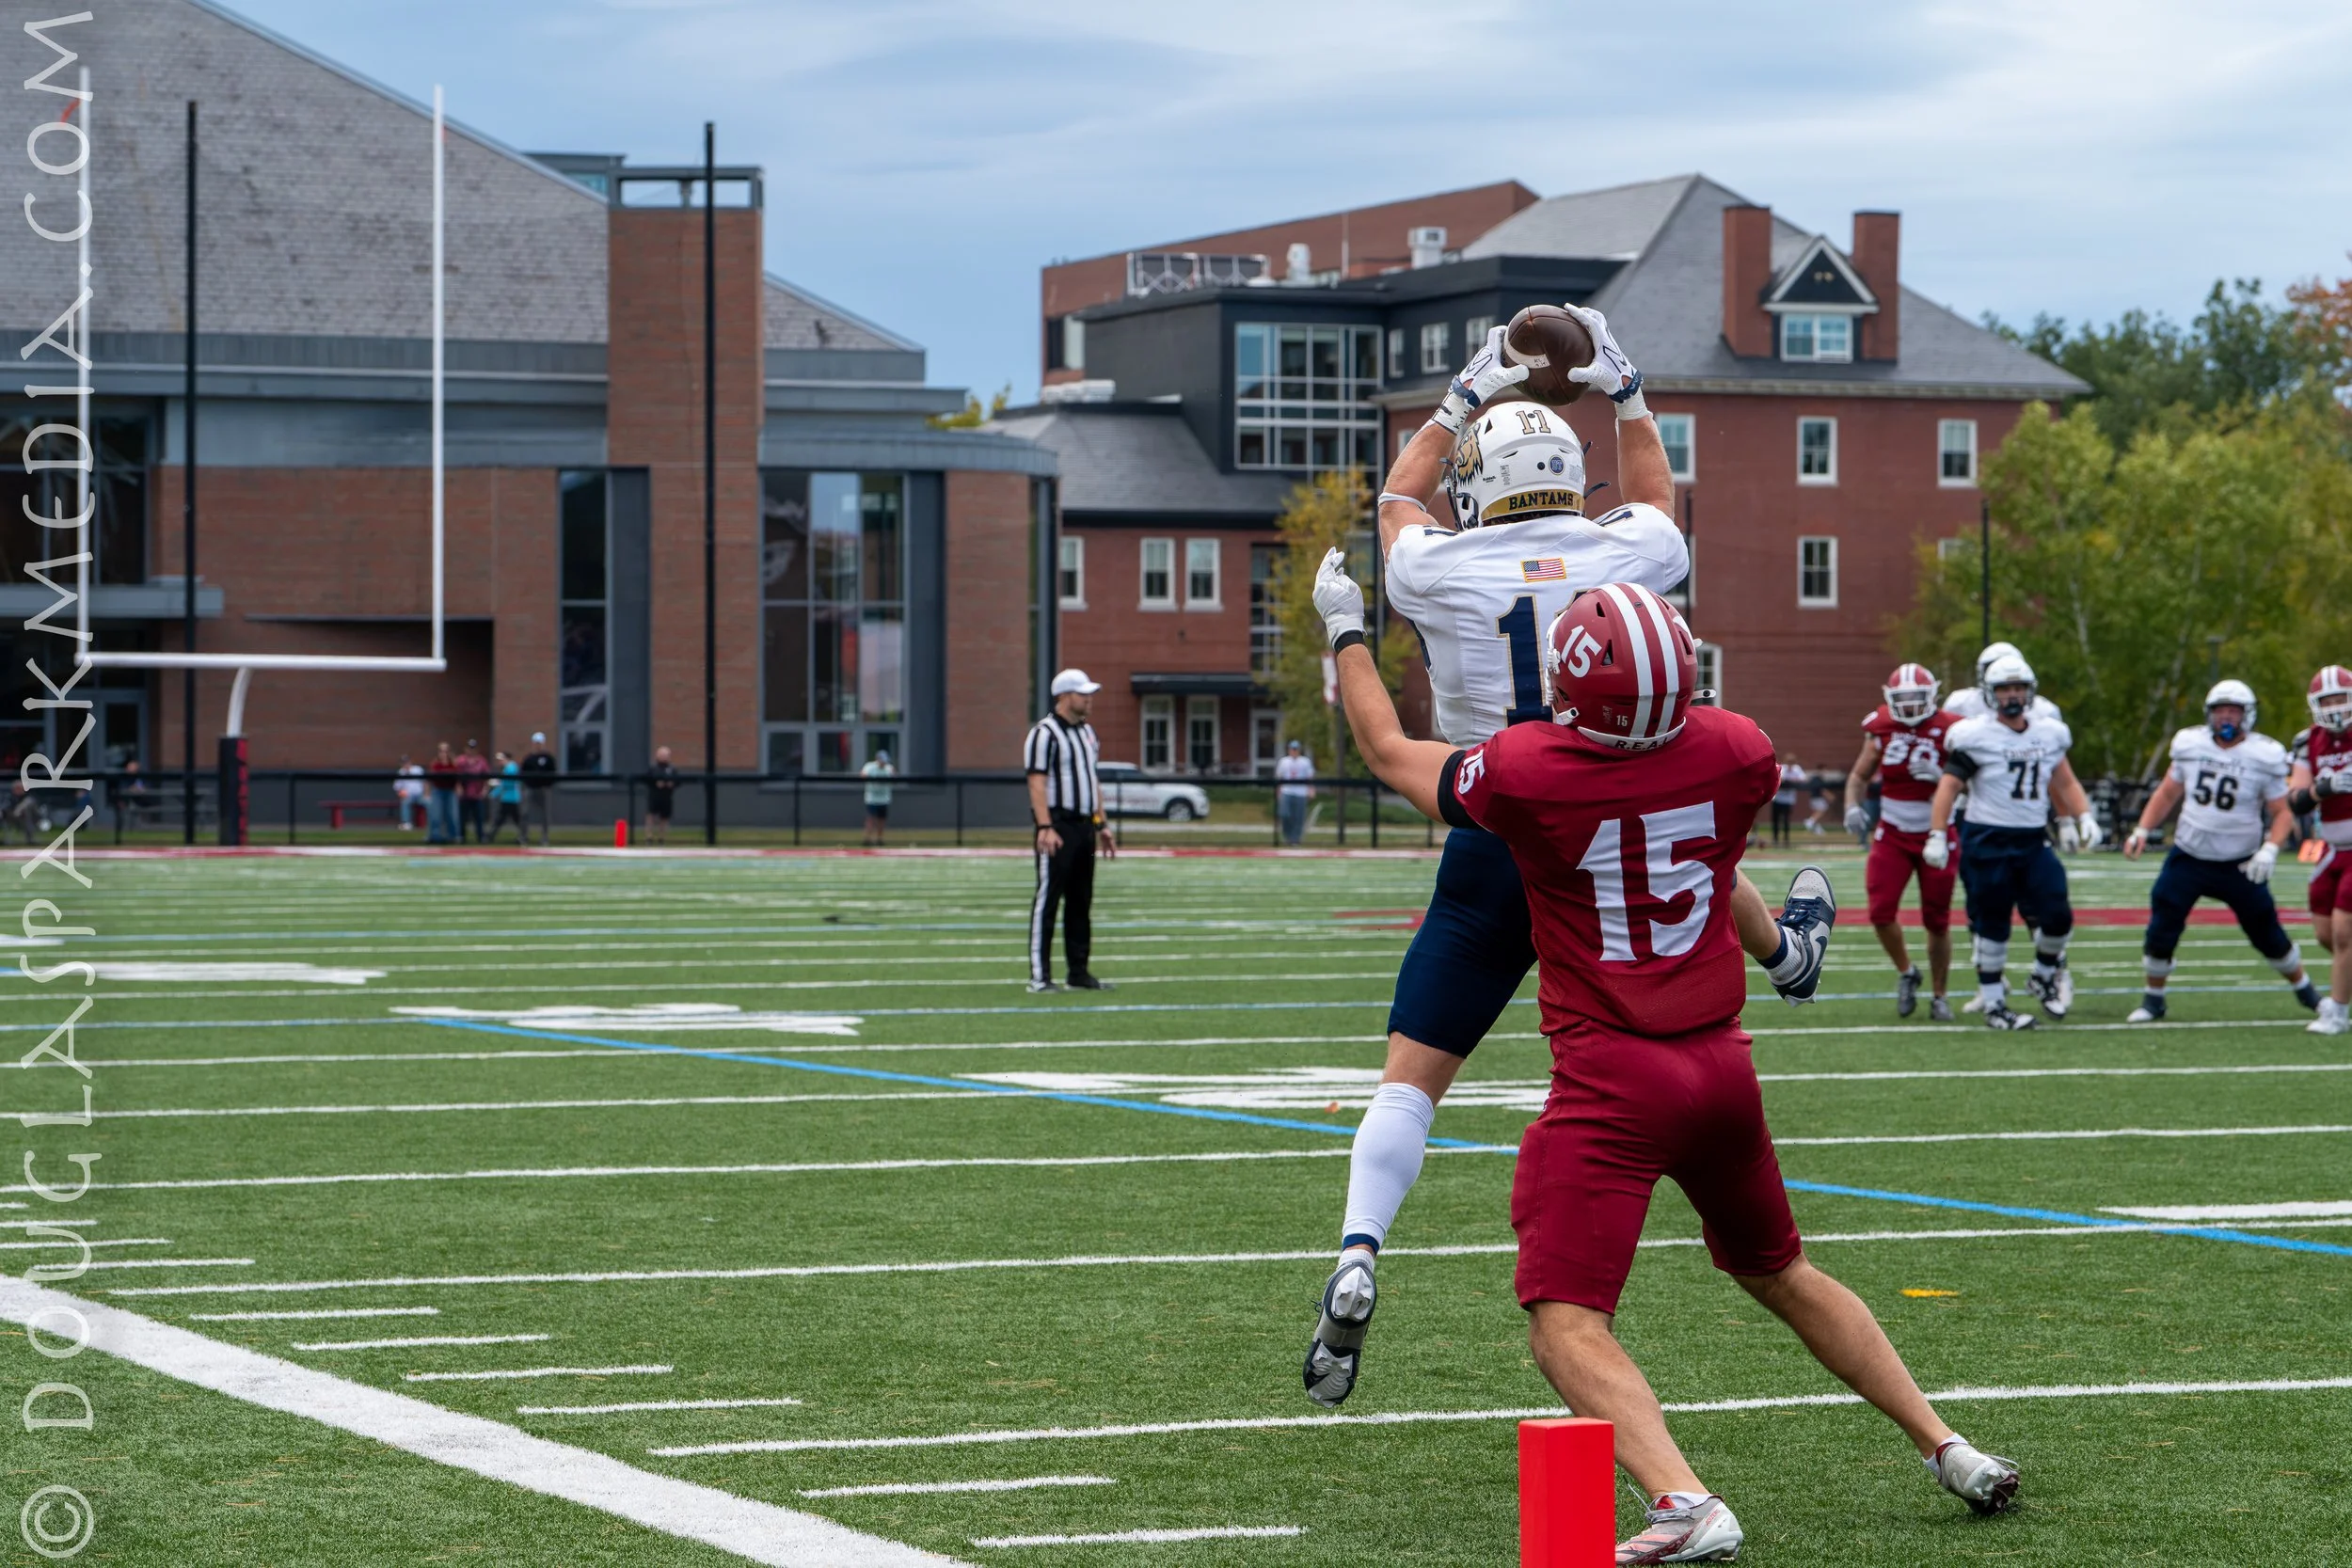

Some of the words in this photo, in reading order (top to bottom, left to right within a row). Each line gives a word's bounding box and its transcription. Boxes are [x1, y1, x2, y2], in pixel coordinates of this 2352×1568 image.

[1516, 409, 1551, 435] 11
[1508, 492, 1574, 511] BANTAMS
[1496, 589, 1588, 727] 1
[1561, 625, 1603, 678] 15
[1615, 714, 1629, 727] 15
[1457, 749, 1486, 795] 15
[2008, 760, 2040, 800] 71
[2192, 769, 2239, 812] 56
[1575, 800, 1717, 961] 15
